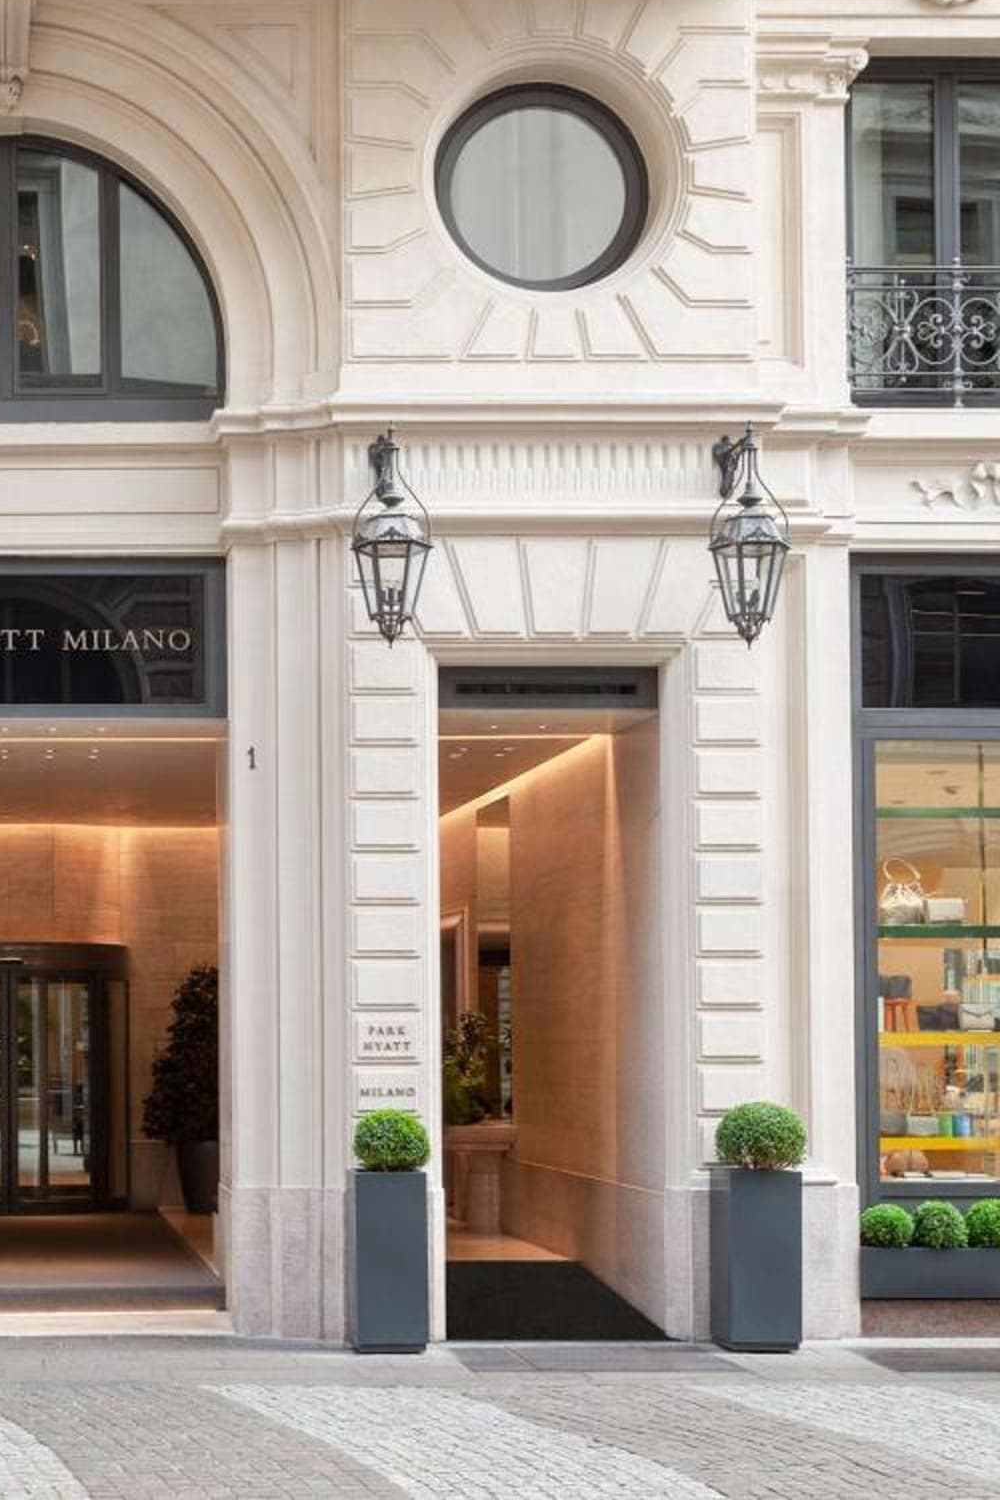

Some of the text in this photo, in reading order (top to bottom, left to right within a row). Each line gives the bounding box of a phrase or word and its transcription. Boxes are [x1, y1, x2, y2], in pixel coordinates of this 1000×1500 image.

[61, 629, 191, 651] MILANO
[247, 745, 256, 770] 1
[368, 1026, 406, 1036] PARK
[363, 1041, 411, 1051] HYATT
[360, 1087, 416, 1097] MILANO
